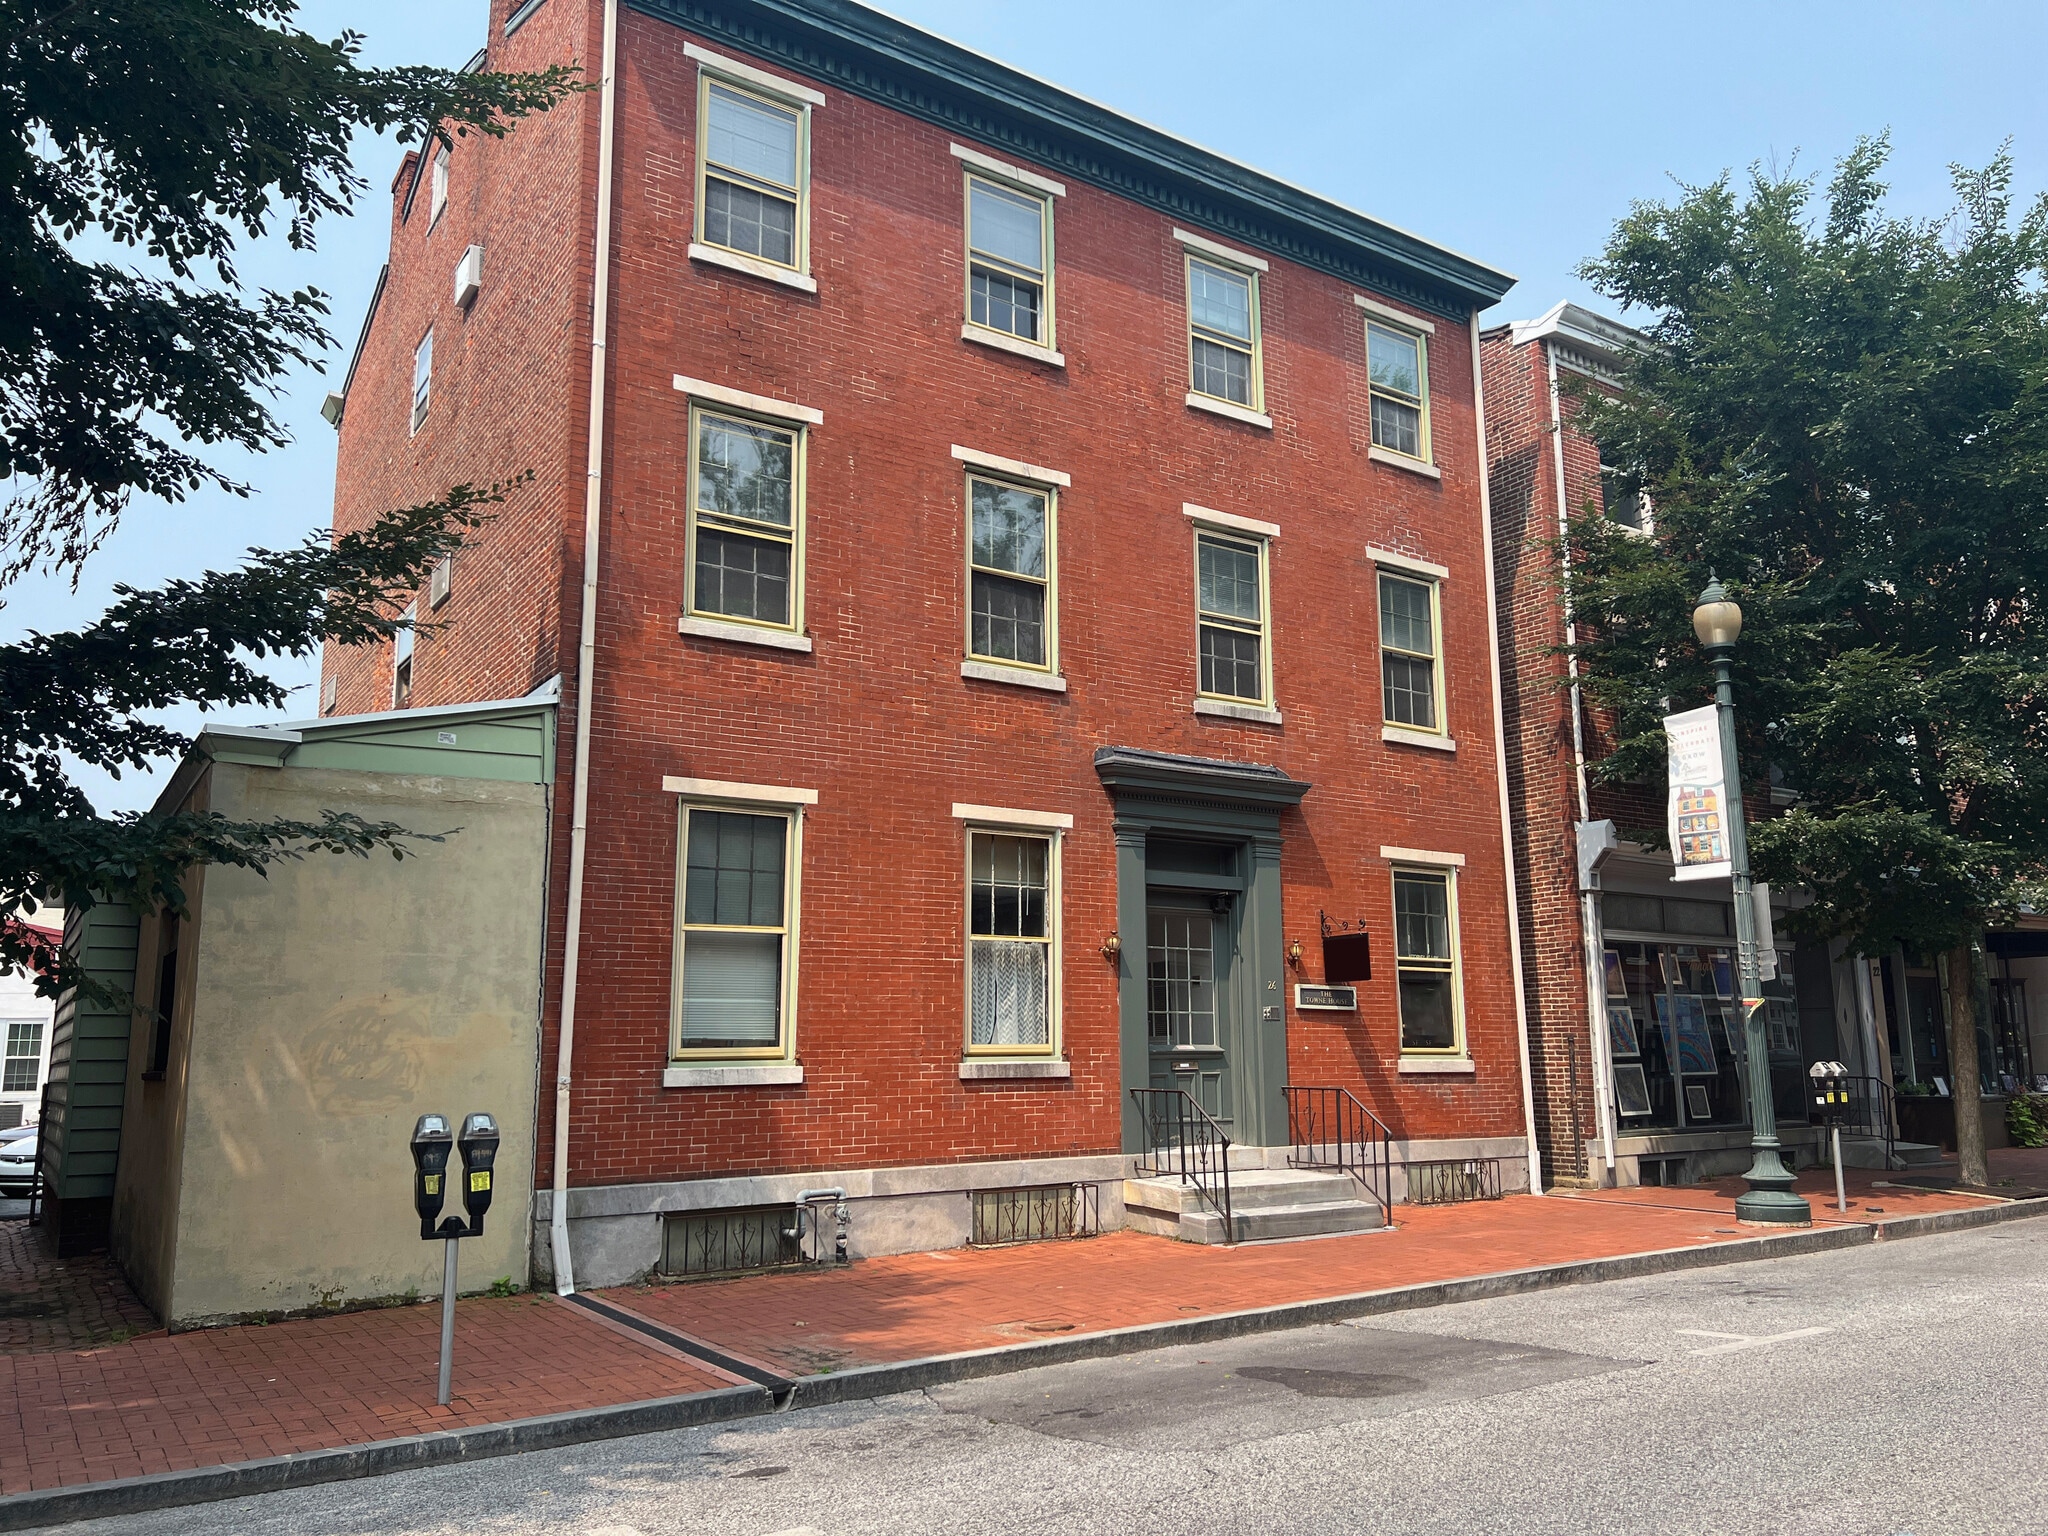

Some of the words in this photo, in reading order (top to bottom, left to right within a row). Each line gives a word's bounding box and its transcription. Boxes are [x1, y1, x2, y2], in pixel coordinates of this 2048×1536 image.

[1672, 737, 1714, 750] ELEBRATE
[1682, 752, 1705, 760] GROW
[1873, 966, 1880, 976] 22
[1267, 980, 1277, 990] 26
[1320, 990, 1333, 998] THE
[1305, 996, 1327, 1004] TOWNE
